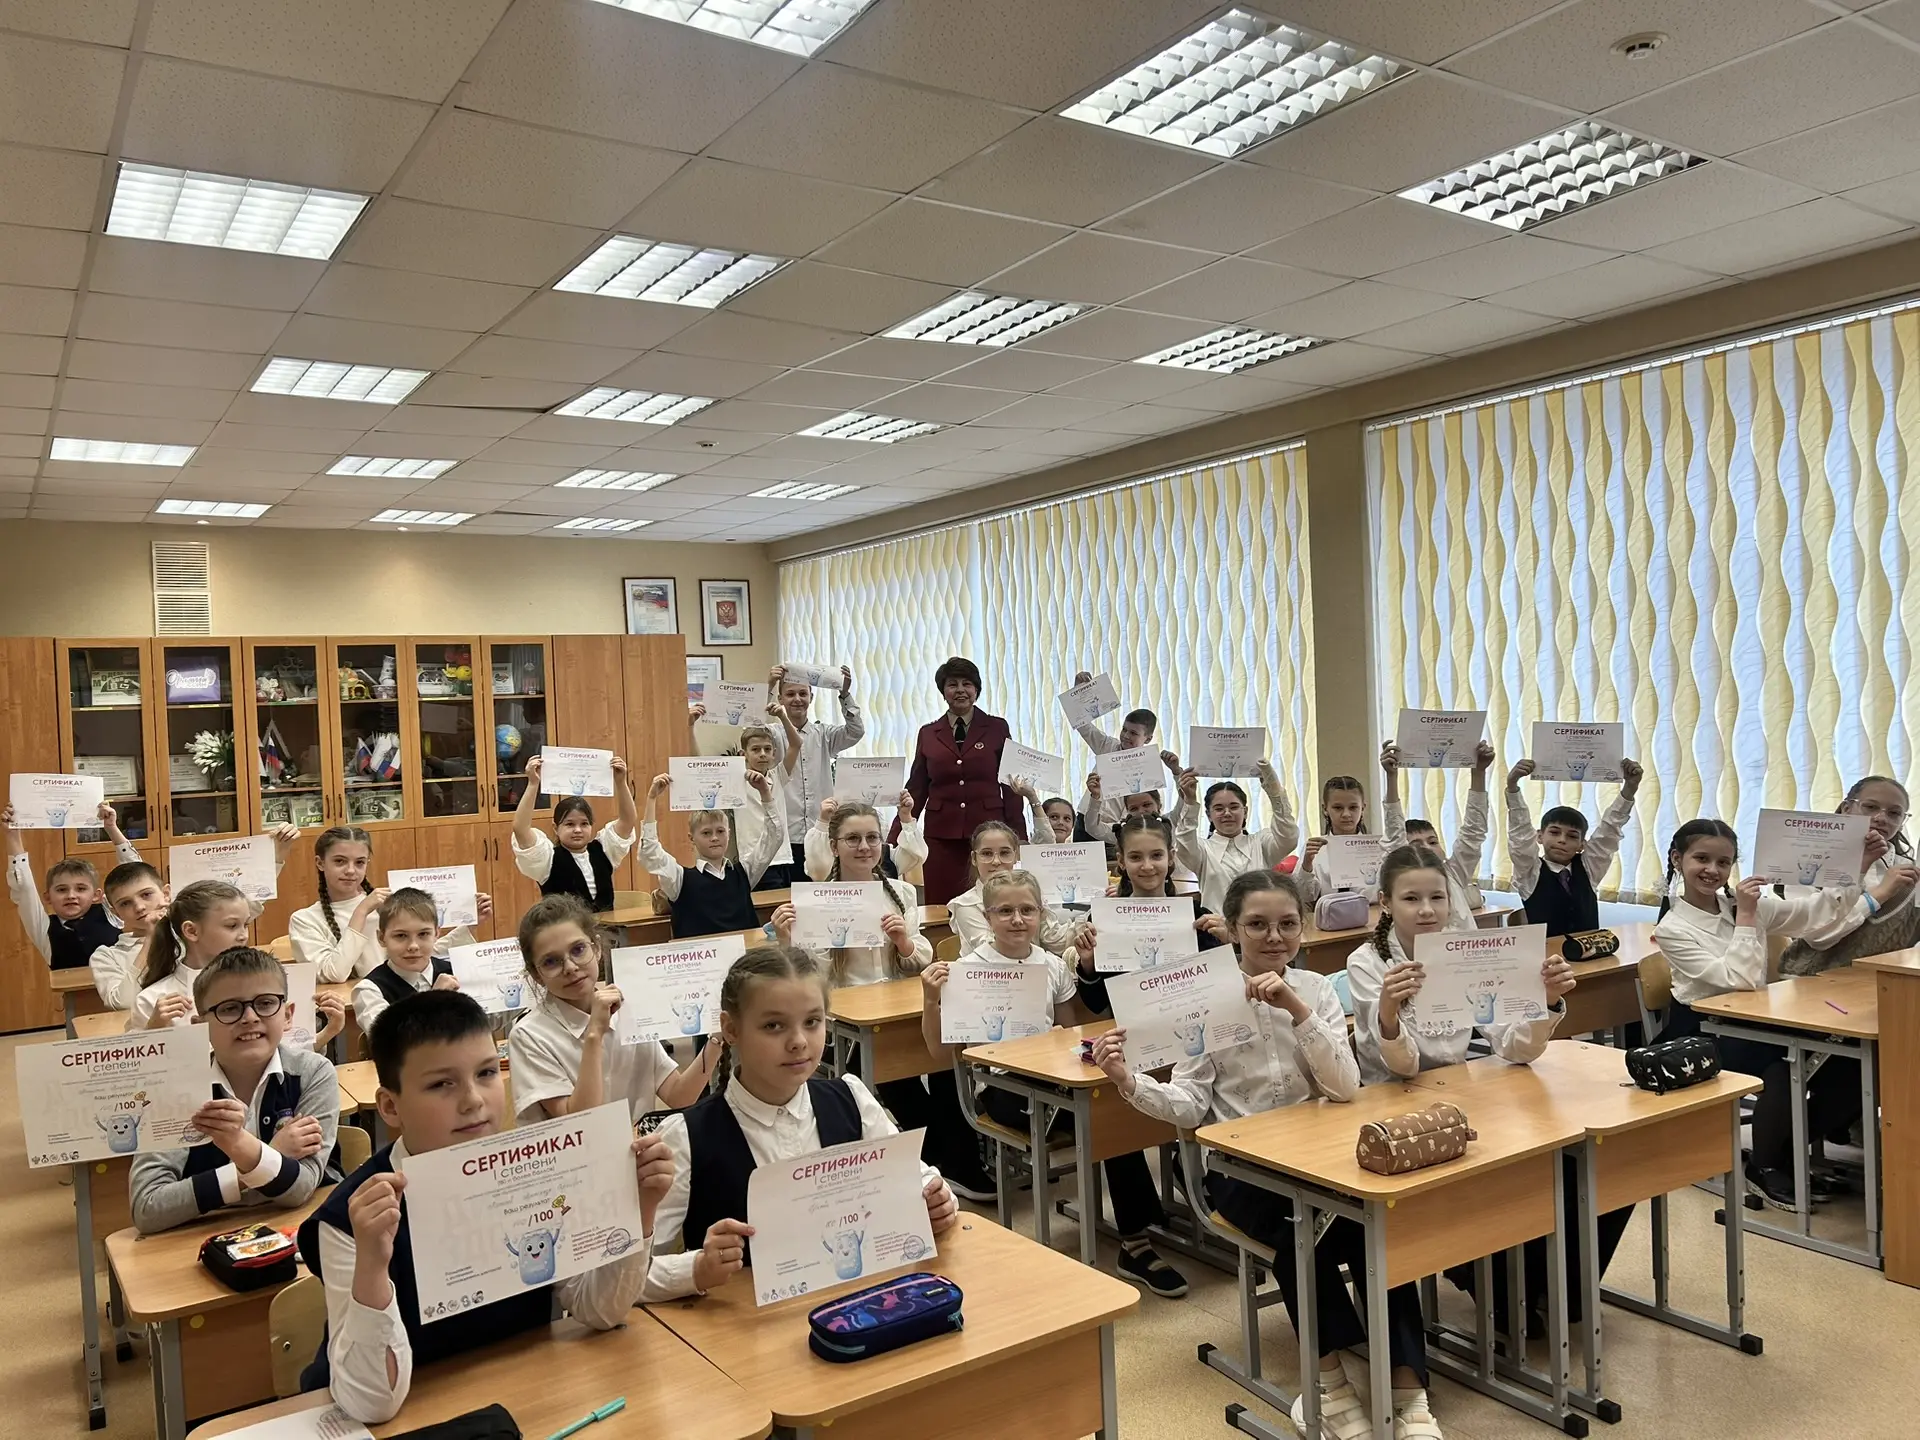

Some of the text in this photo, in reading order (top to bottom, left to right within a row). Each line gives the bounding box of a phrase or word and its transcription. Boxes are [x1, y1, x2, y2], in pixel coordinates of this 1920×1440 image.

[1784, 819, 1846, 830] СЕРТИФИКАТ
[194, 842, 252, 856] СЕРТИФИКАТ
[1040, 849, 1087, 858] СЕРТИФИКАТ
[409, 873, 457, 883] СЕРТИФИКАТ
[813, 889, 863, 897] СЕРТИФИКАТ
[1115, 905, 1172, 914] СЕРТИФИКАТ
[475, 944, 522, 958] СЕРТИФИК
[1445, 936, 1517, 952] СЕРТИФИКАТ
[645, 949, 718, 967] СЕРТИФИКАТ
[965, 970, 1024, 980] СЕРТИФИКАТ
[1139, 963, 1210, 992] СЕРТИФИКАТ
[1479, 980, 1494, 989] /100
[1184, 1011, 1200, 1022] /100
[61, 1042, 166, 1068] СЕРТИФИКАТ
[93, 1060, 141, 1072] степени
[114, 1100, 136, 1112] /100
[461, 1130, 585, 1177] СЕРТИФИКАТ
[500, 1155, 558, 1179] степени
[792, 1148, 887, 1182] СЕРТИФИКАТ
[819, 1166, 863, 1184] степени
[528, 1209, 555, 1228] /100
[838, 1212, 859, 1228] /100
